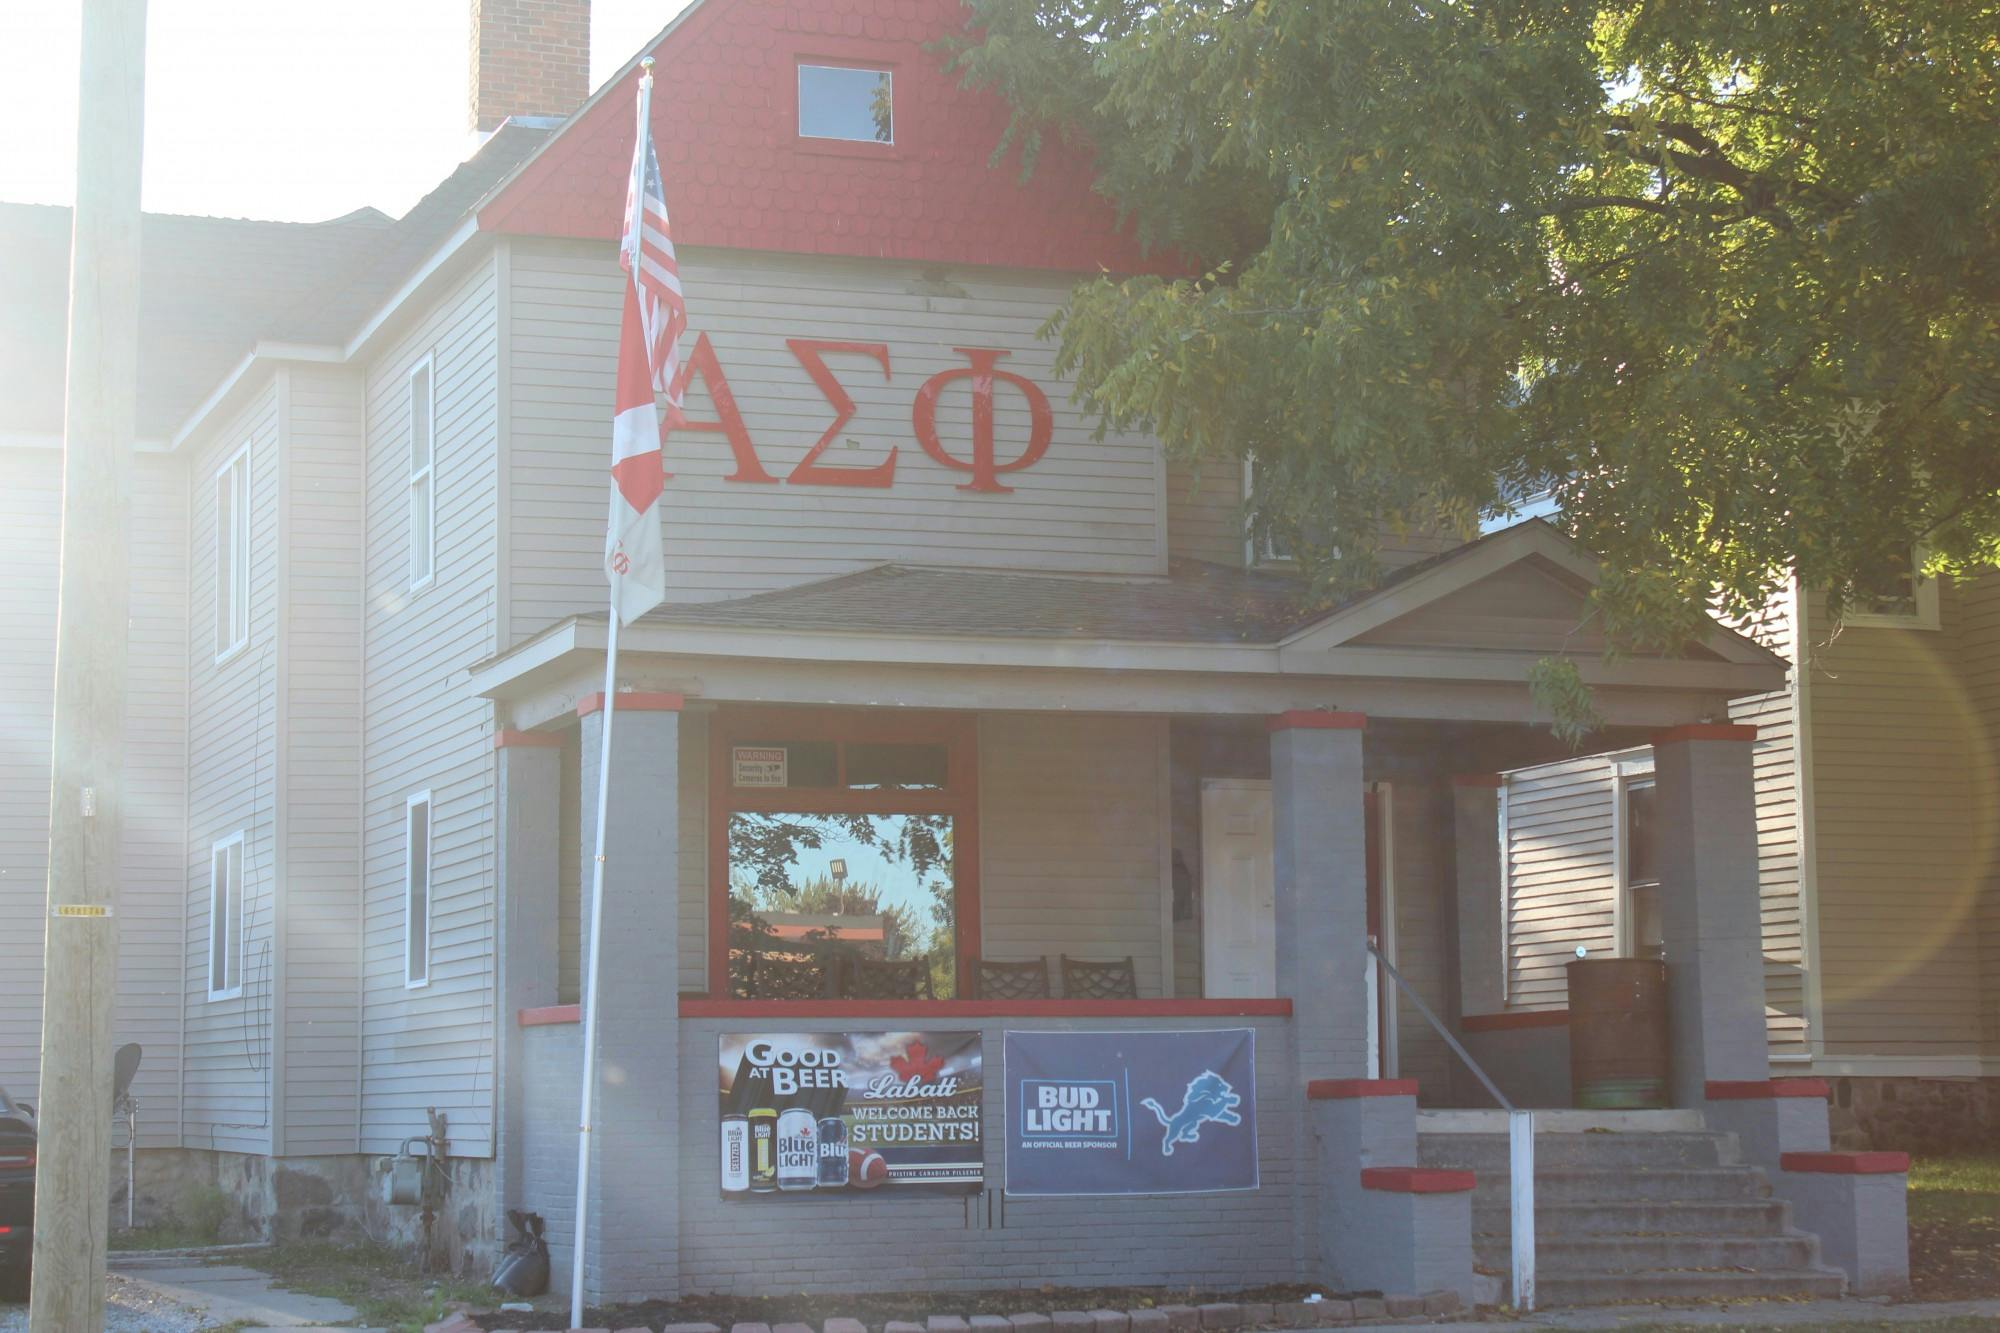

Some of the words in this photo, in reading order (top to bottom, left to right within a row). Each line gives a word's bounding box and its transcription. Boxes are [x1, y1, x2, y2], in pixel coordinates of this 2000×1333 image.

[736, 751, 782, 761] WARNING
[744, 1039, 841, 1067] GOOD
[749, 1067, 770, 1079] AT
[773, 1067, 849, 1096] BEER
[863, 1074, 958, 1099] Labatt
[1038, 1086, 1099, 1109] BUD
[852, 1106, 933, 1120] WELCOME
[936, 1105, 979, 1119] BACK
[1027, 1109, 1111, 1132] LIGHT
[852, 1121, 980, 1142] STUDENTS!
[778, 1136, 815, 1153] Blue
[1022, 1141, 1033, 1149] AN
[1033, 1141, 1064, 1149] OFFICIAL
[1065, 1141, 1082, 1149] BEER
[1083, 1141, 1117, 1149] SPONSOR
[778, 1153, 815, 1168] LIGHT
